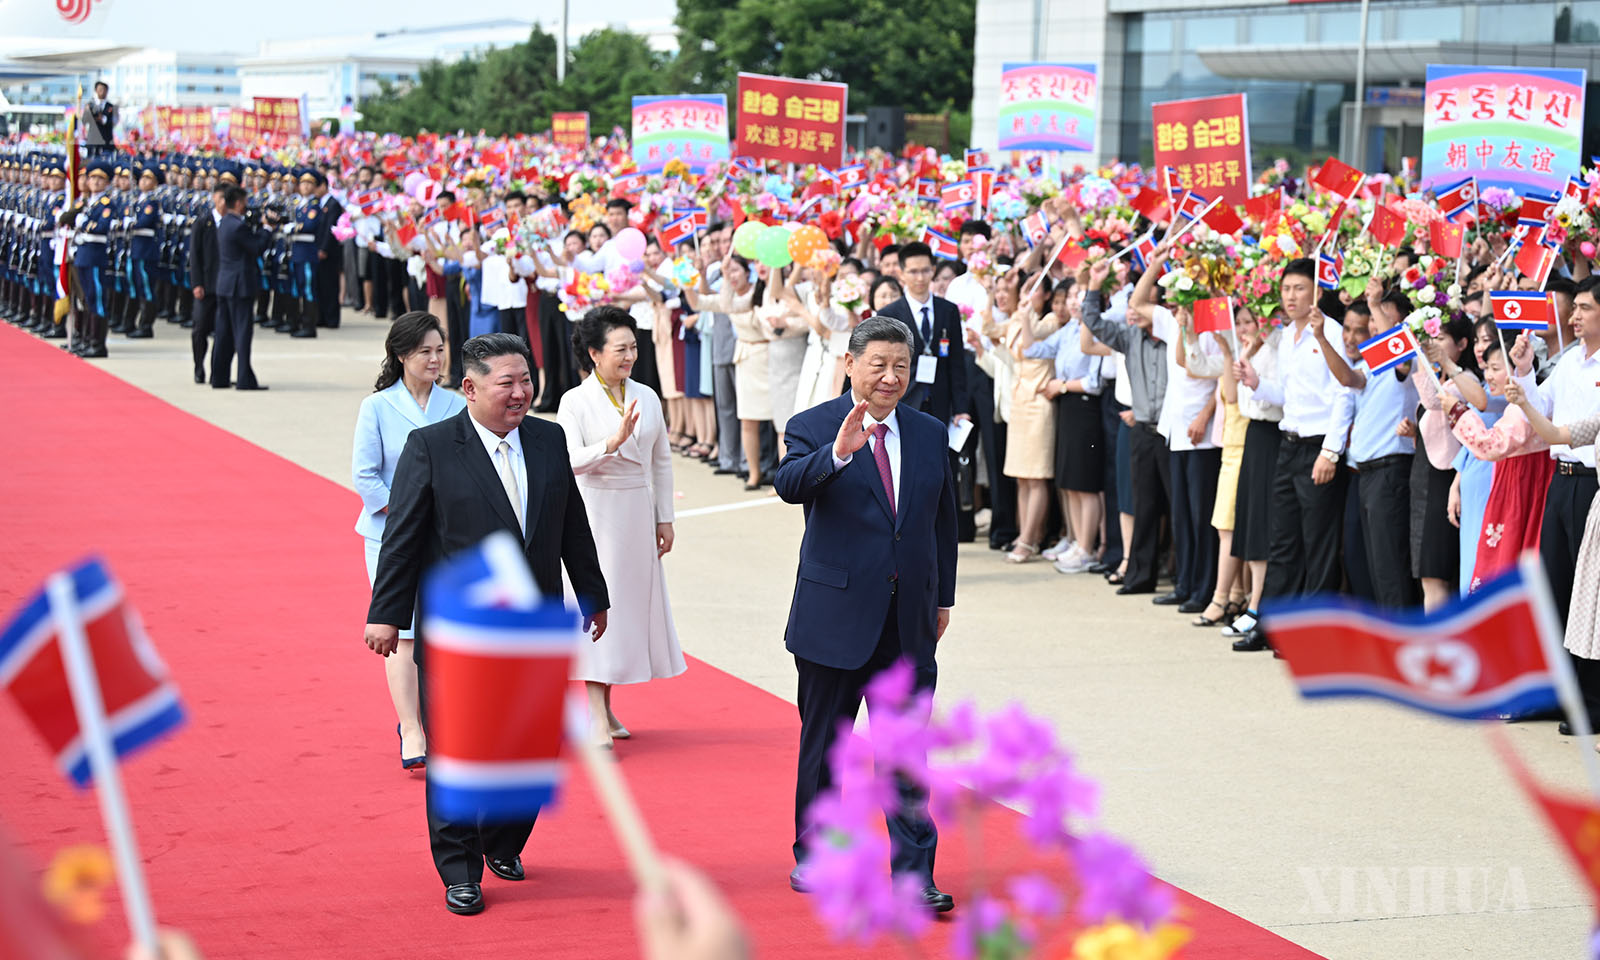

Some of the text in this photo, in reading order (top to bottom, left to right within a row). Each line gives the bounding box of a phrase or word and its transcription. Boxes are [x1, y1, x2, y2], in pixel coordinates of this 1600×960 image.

[742, 89, 841, 124] 환송 습근평
[1434, 84, 1574, 129] 조중친선
[744, 123, 837, 154] 欢送习近平
[1156, 114, 1242, 152] 환송 습근평
[1444, 138, 1557, 174] 朝中友谊
[1163, 159, 1242, 190] 送习近平
